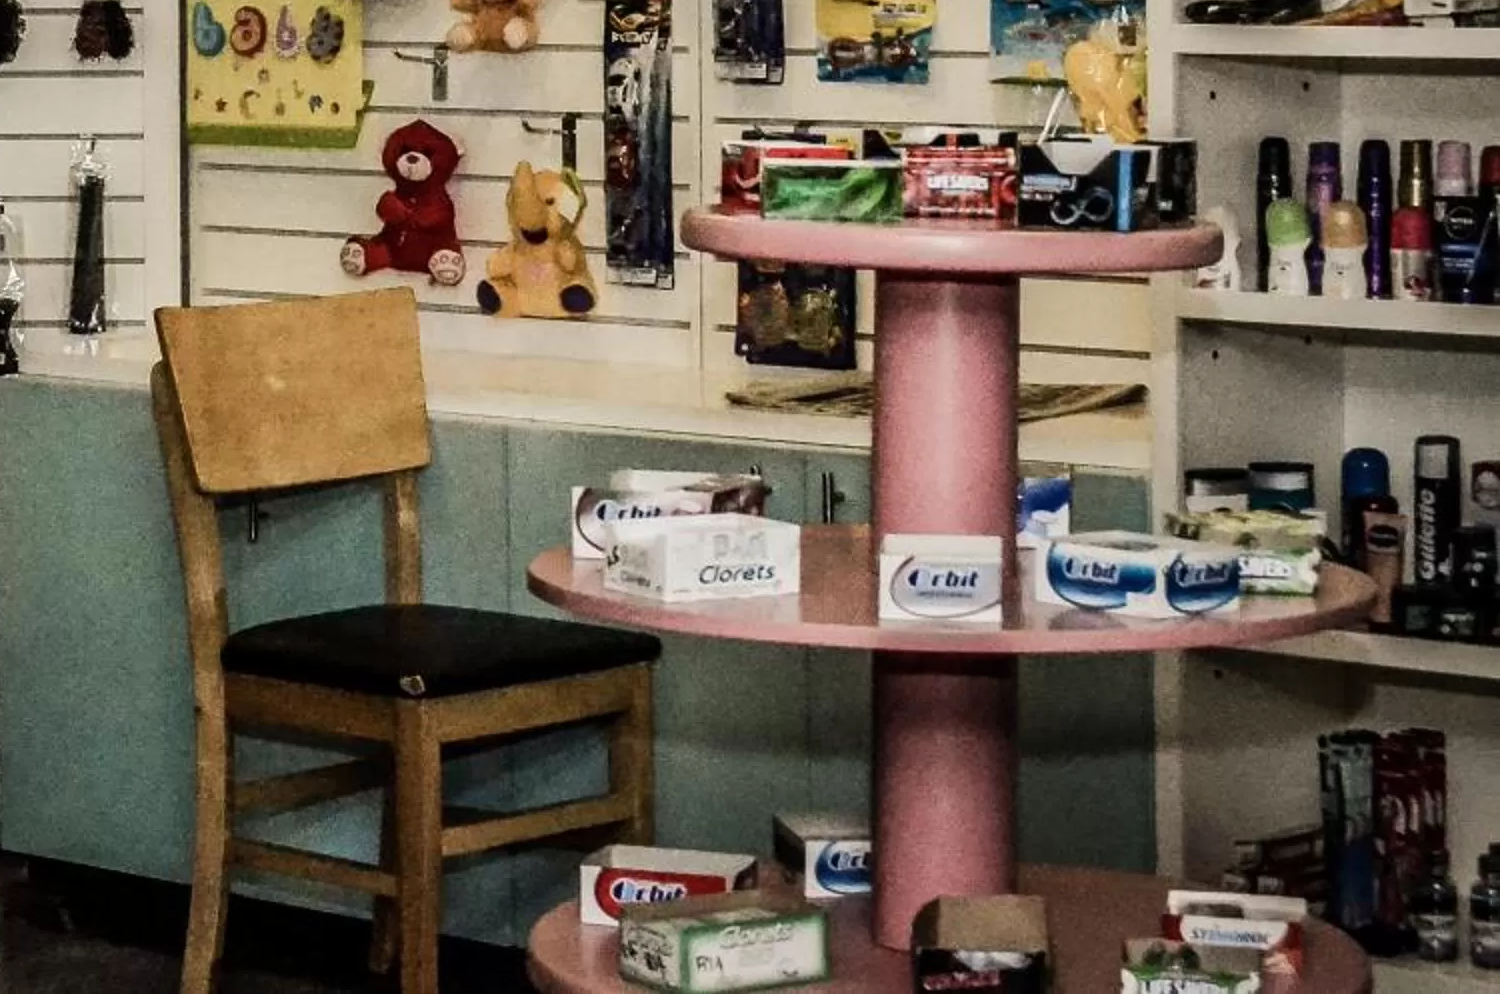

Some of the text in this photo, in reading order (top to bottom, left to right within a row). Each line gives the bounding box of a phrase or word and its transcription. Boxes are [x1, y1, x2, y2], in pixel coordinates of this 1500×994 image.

[698, 563, 776, 585] Clorets
[907, 568, 979, 588] Orbit
[1064, 557, 1118, 583] Orbit
[612, 879, 685, 903] Orbit
